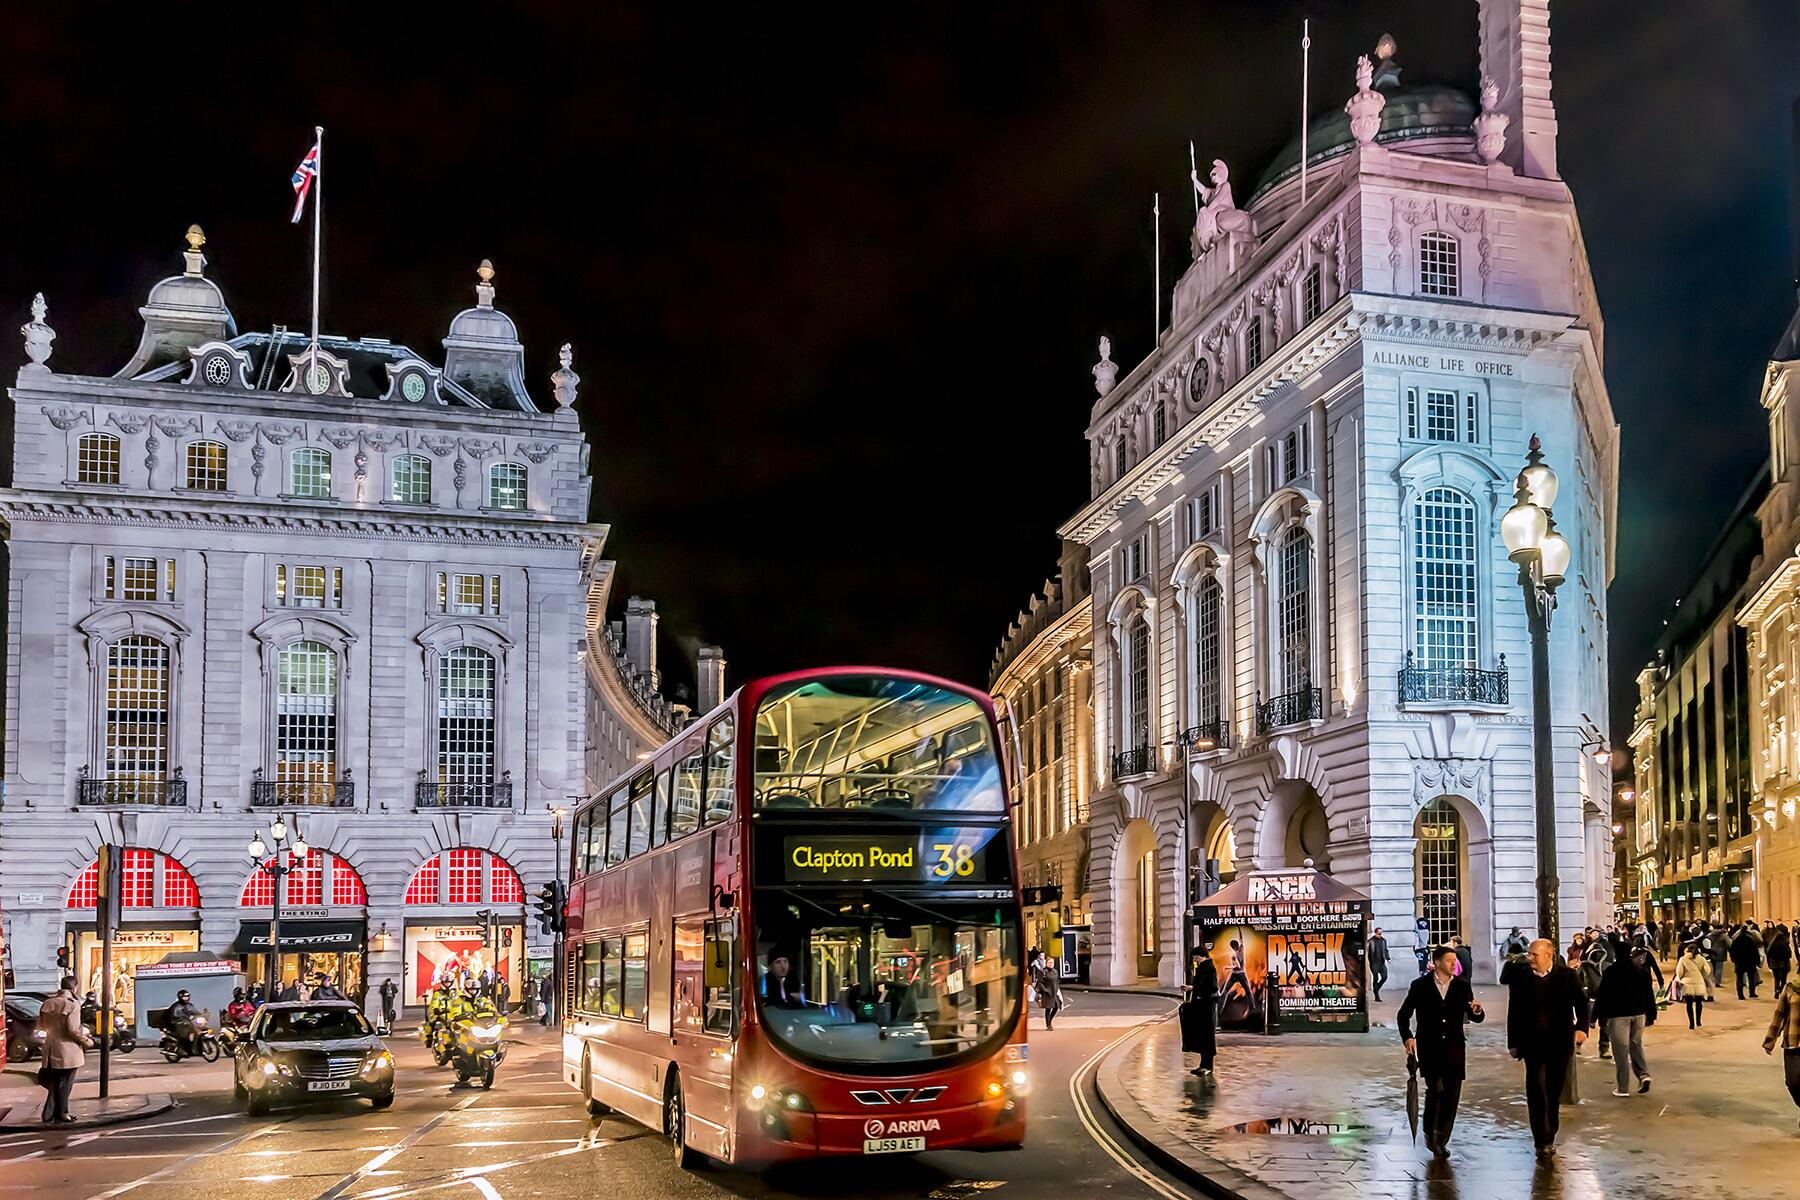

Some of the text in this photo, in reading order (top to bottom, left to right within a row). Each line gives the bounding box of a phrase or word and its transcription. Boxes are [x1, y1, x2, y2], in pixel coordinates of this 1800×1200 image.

[1373, 352, 1513, 376] ALLIANCE LIFE OFFICE
[792, 847, 913, 873] Clapton Pond
[933, 844, 975, 877] 38
[1248, 876, 1315, 901] ROCK
[1218, 906, 1232, 917] WE
[1233, 905, 1255, 917] WILL
[1258, 904, 1272, 916] WE
[1274, 903, 1297, 915] WILL
[1301, 902, 1325, 915] ROCK
[1328, 902, 1348, 914] YOU
[1224, 917, 1245, 925] PRICE
[1297, 915, 1319, 923] BOOK
[1288, 933, 1325, 943] WE WILL
[1267, 933, 1347, 986] ROCK
[1306, 971, 1347, 985] YOU
[1279, 997, 1357, 1007] DOMINION THEATRE
[887, 1119, 941, 1134] ARRIVA
[868, 1138, 921, 1152] LJ59 AET
